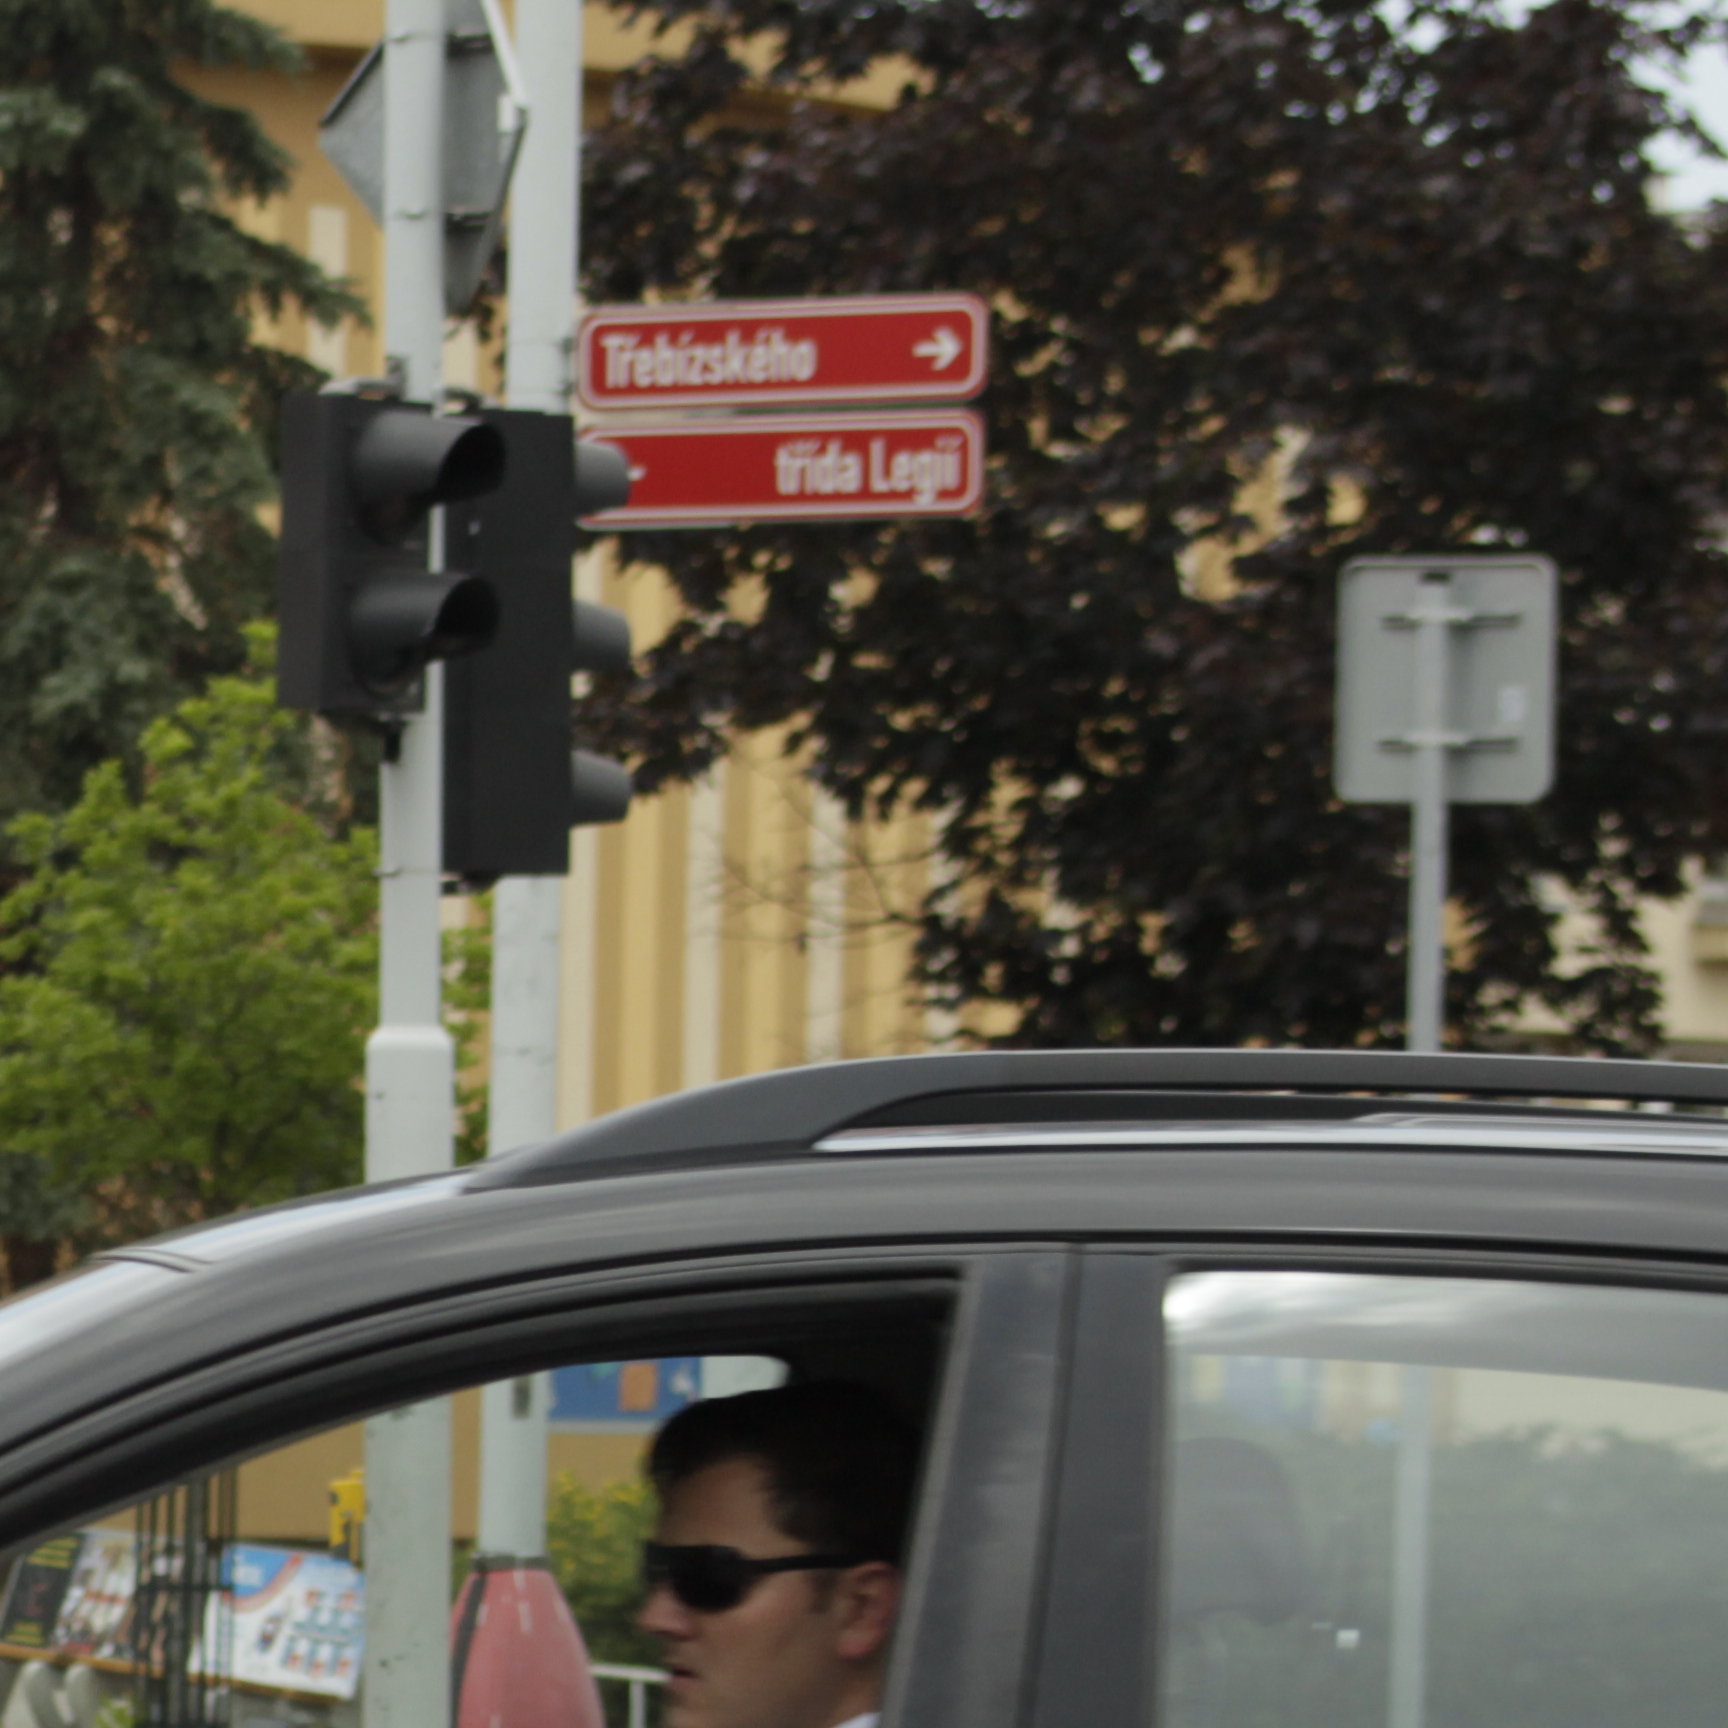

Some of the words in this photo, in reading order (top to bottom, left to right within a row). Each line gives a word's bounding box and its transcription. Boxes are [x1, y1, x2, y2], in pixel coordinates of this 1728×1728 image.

[599, 328, 817, 389] Třebízského
[774, 438, 863, 496] třída
[869, 434, 965, 507] Legií
